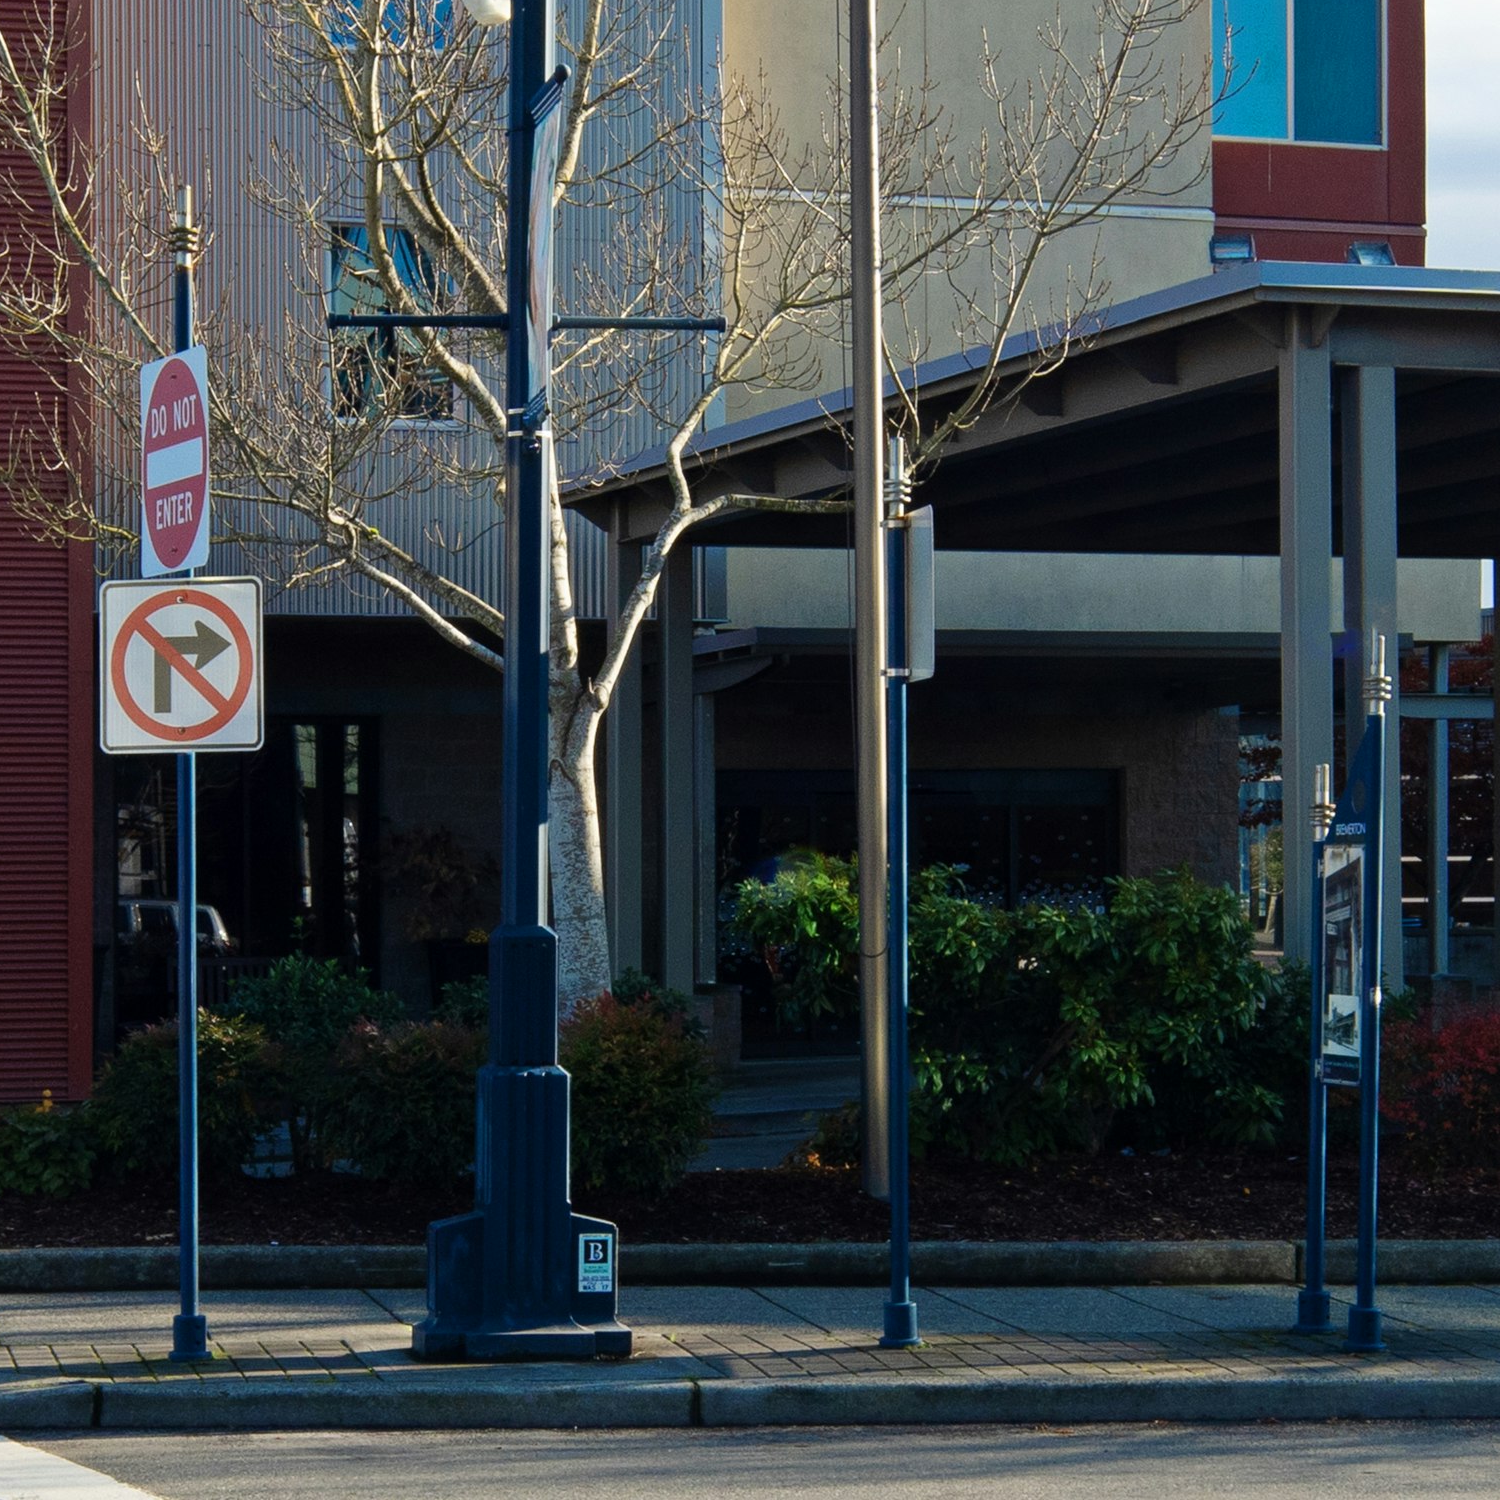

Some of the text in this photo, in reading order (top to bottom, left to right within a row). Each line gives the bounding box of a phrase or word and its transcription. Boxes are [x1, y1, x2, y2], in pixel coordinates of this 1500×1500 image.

[151, 394, 197, 439] DO NOT
[156, 491, 193, 530] ENTER
[1335, 822, 1366, 836] BREMERTON
[588, 1242, 603, 1261] B
